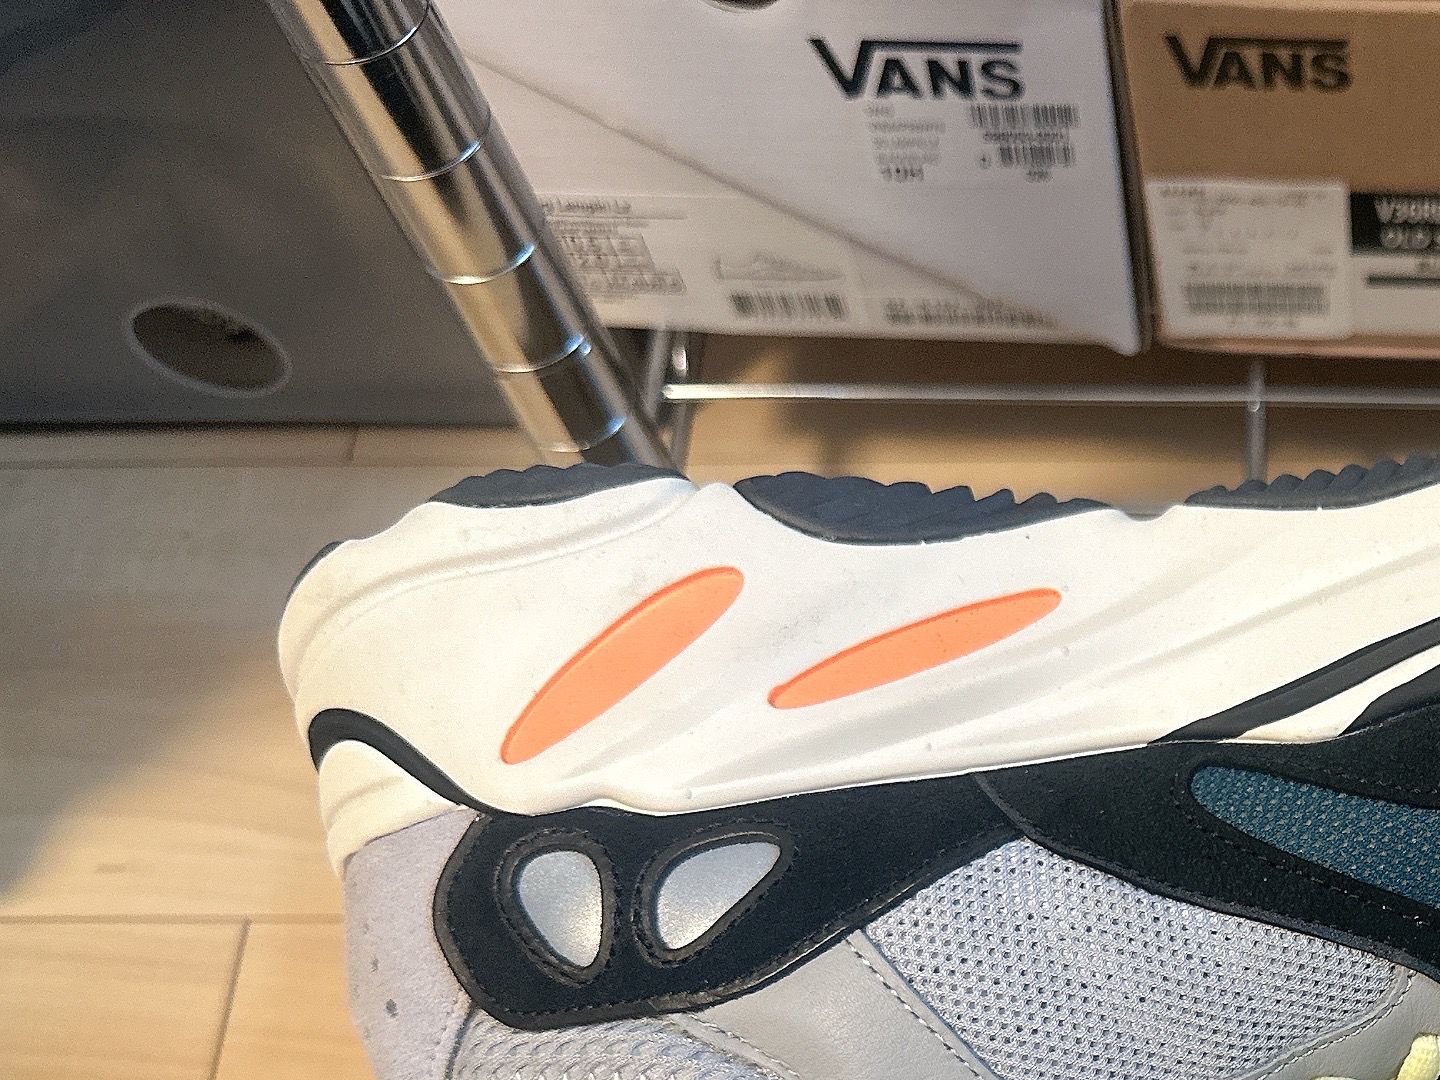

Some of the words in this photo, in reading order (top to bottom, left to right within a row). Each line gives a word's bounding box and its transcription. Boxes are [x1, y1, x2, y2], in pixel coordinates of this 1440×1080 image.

[808, 38, 1025, 100] VANS
[1163, 32, 1352, 92] VANS
[1380, 225, 1432, 250] OLD
